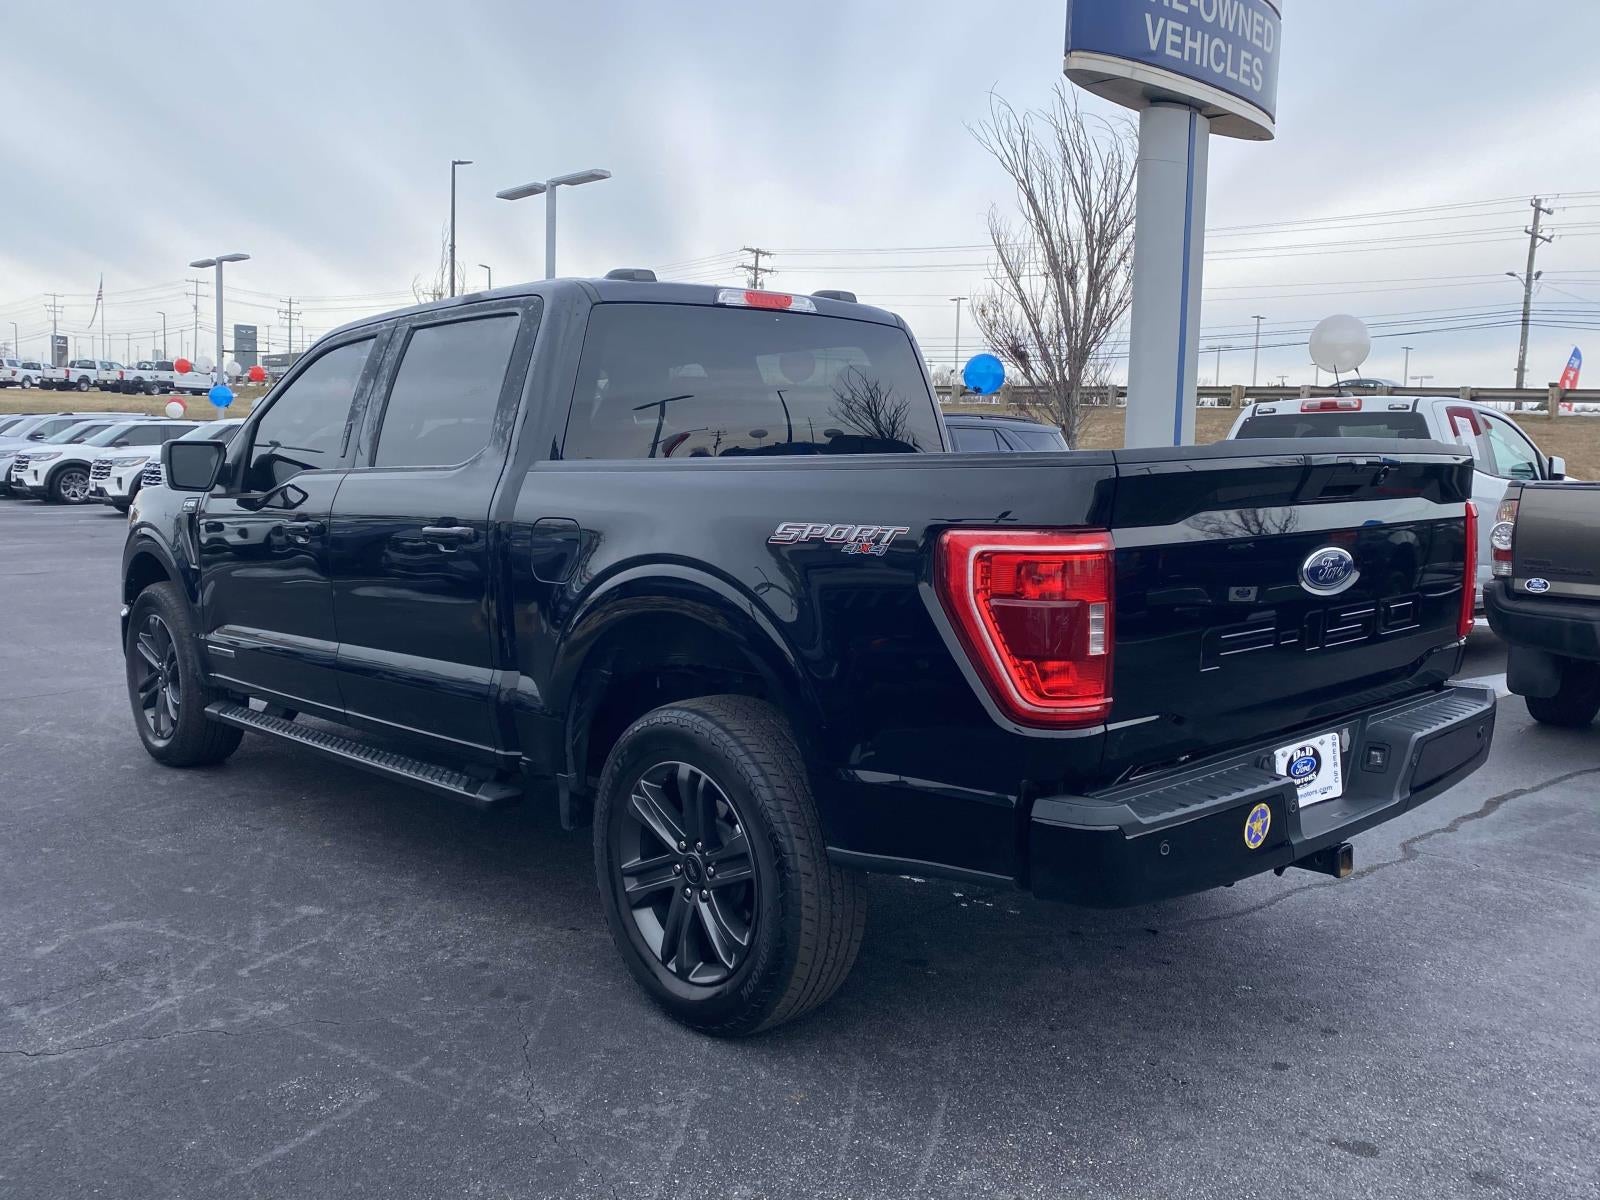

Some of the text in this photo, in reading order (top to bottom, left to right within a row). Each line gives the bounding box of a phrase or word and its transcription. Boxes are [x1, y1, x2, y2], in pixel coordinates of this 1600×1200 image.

[1144, 12, 1264, 93] VEHICLES
[768, 522, 910, 545] SPORT
[1295, 760, 1313, 775] Ford
[1333, 770, 1339, 783] SC
